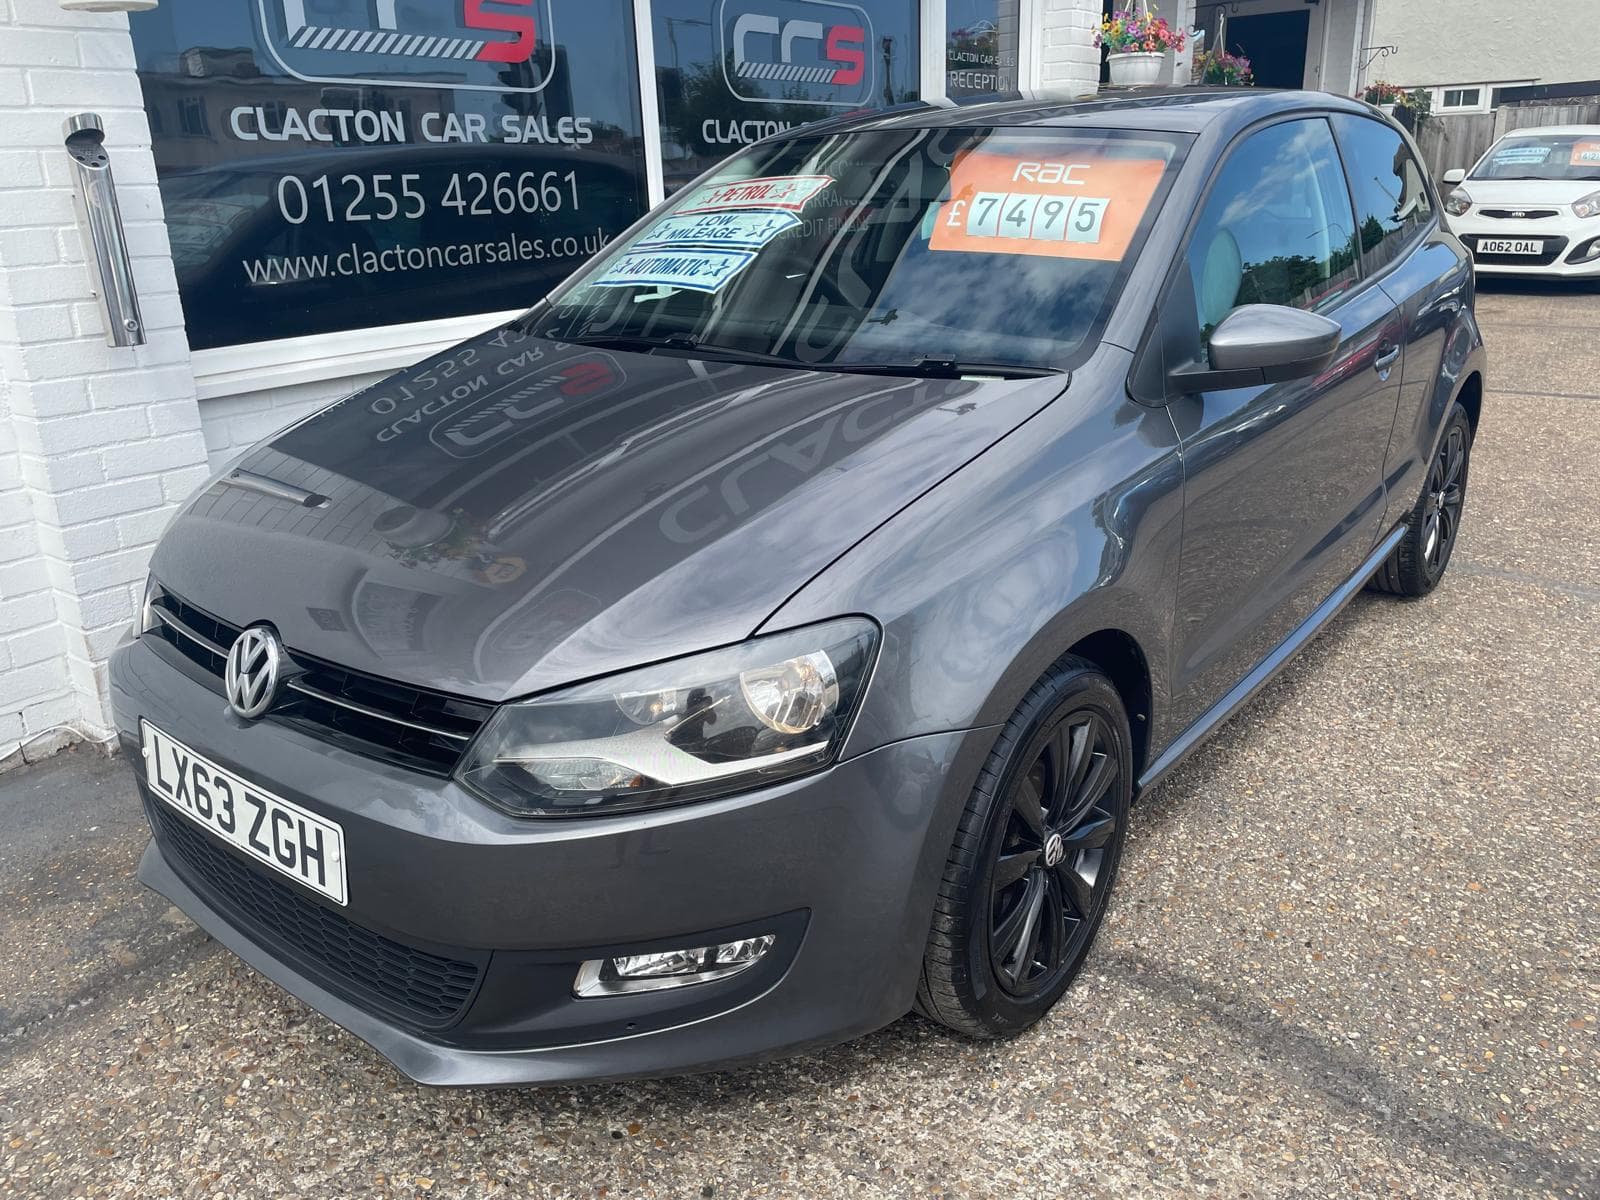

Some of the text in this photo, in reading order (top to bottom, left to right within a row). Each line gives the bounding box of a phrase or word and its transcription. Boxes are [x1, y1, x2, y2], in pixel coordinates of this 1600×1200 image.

[733, 13, 865, 85] CCS
[949, 50, 979, 63] CLACTON
[980, 54, 994, 65] CAR
[950, 71, 1014, 92] RECEPTION
[230, 106, 594, 144] CLACTON CAR SALES
[277, 170, 579, 225] 01255 426661
[721, 184, 773, 202] PETROL
[695, 215, 738, 227] LOW
[665, 227, 743, 240] MILEAGE
[242, 227, 610, 283] www.clactoncarsales.co.uk
[626, 257, 709, 277] AUTOMATIC
[153, 734, 326, 888] LX63 ZGH
